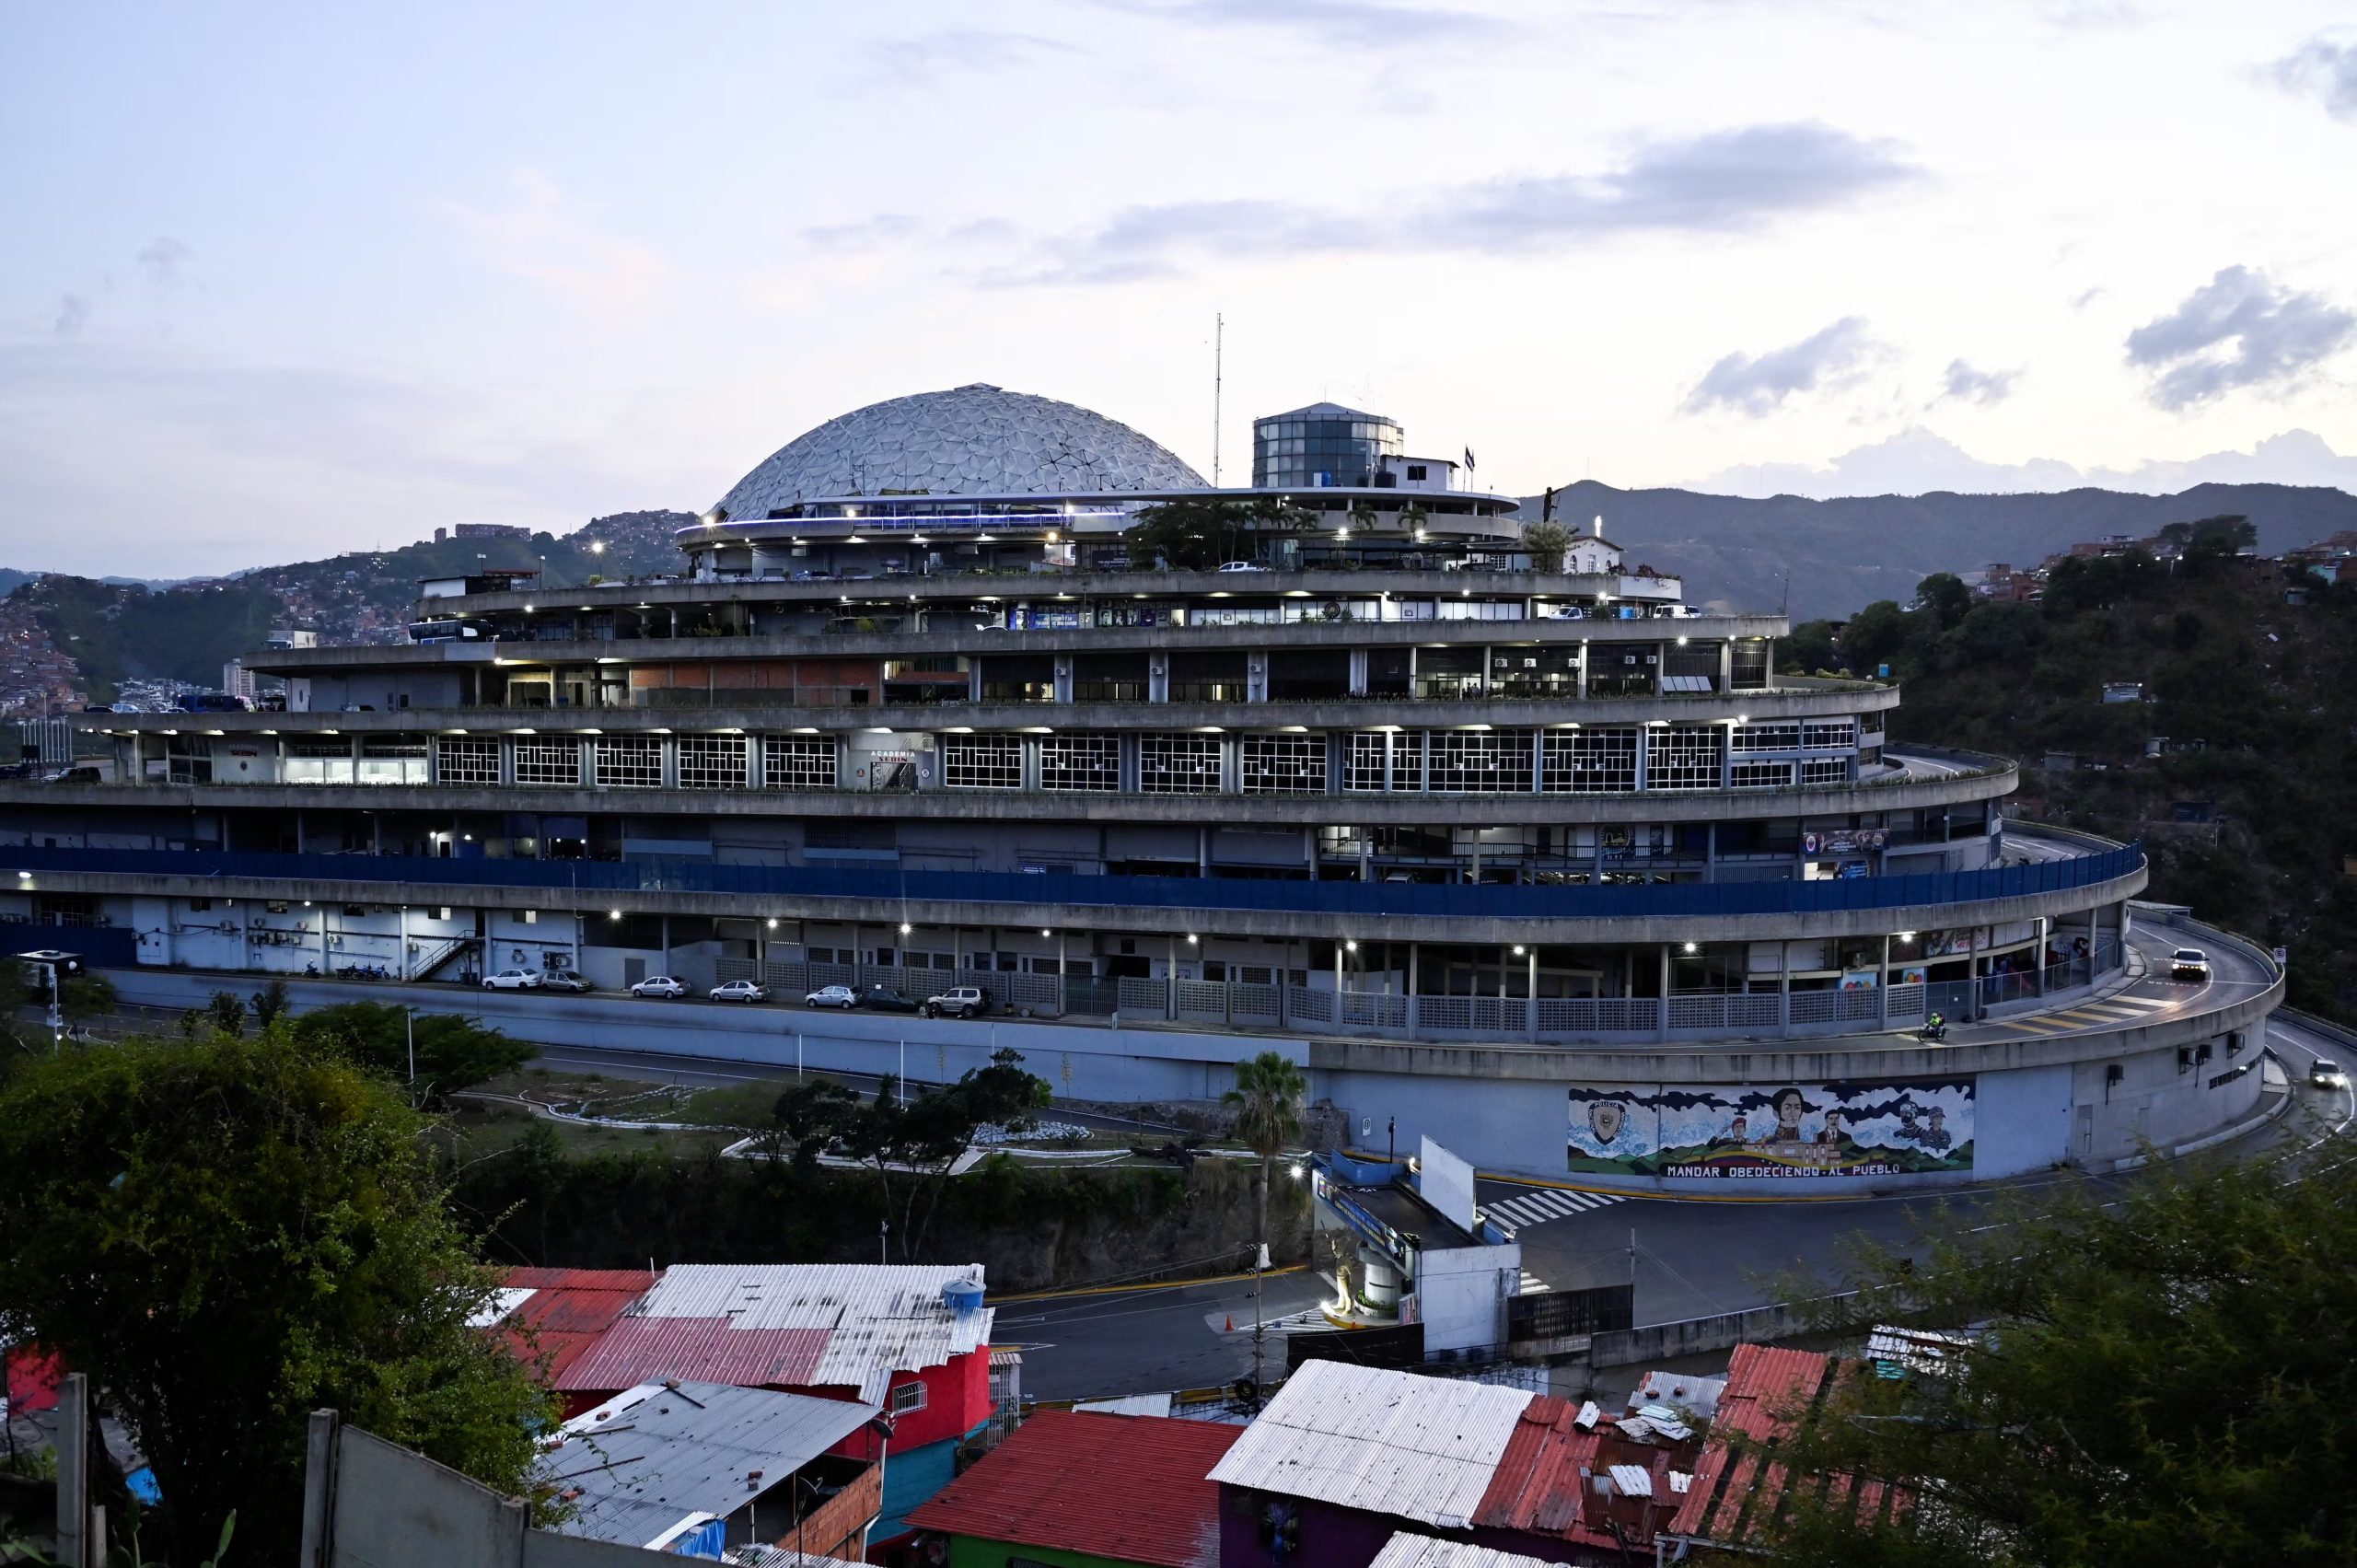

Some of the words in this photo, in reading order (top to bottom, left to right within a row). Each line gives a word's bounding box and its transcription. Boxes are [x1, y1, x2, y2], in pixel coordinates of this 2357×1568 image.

[1667, 1166, 1720, 1178] MANDAR
[1728, 1166, 1819, 1178] OBEDECIENDO
[1828, 1166, 1845, 1177] AL
[1852, 1163, 1900, 1175] PUEBLO
